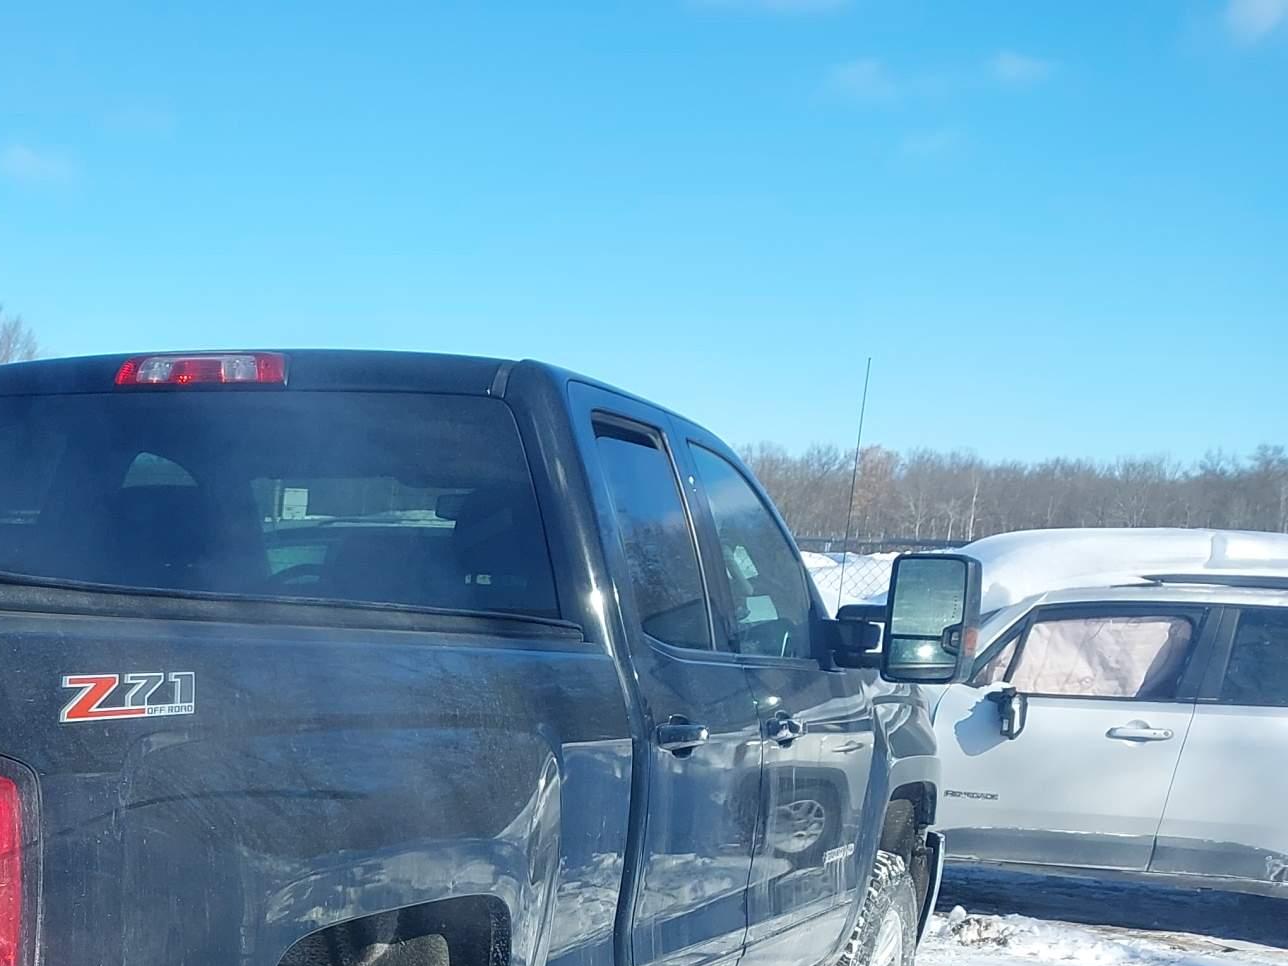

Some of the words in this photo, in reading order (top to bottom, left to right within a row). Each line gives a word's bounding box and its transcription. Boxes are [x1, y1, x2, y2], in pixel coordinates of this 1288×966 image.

[59, 671, 195, 722] Z71
[147, 706, 167, 715] OFF
[168, 704, 193, 713] ROAD
